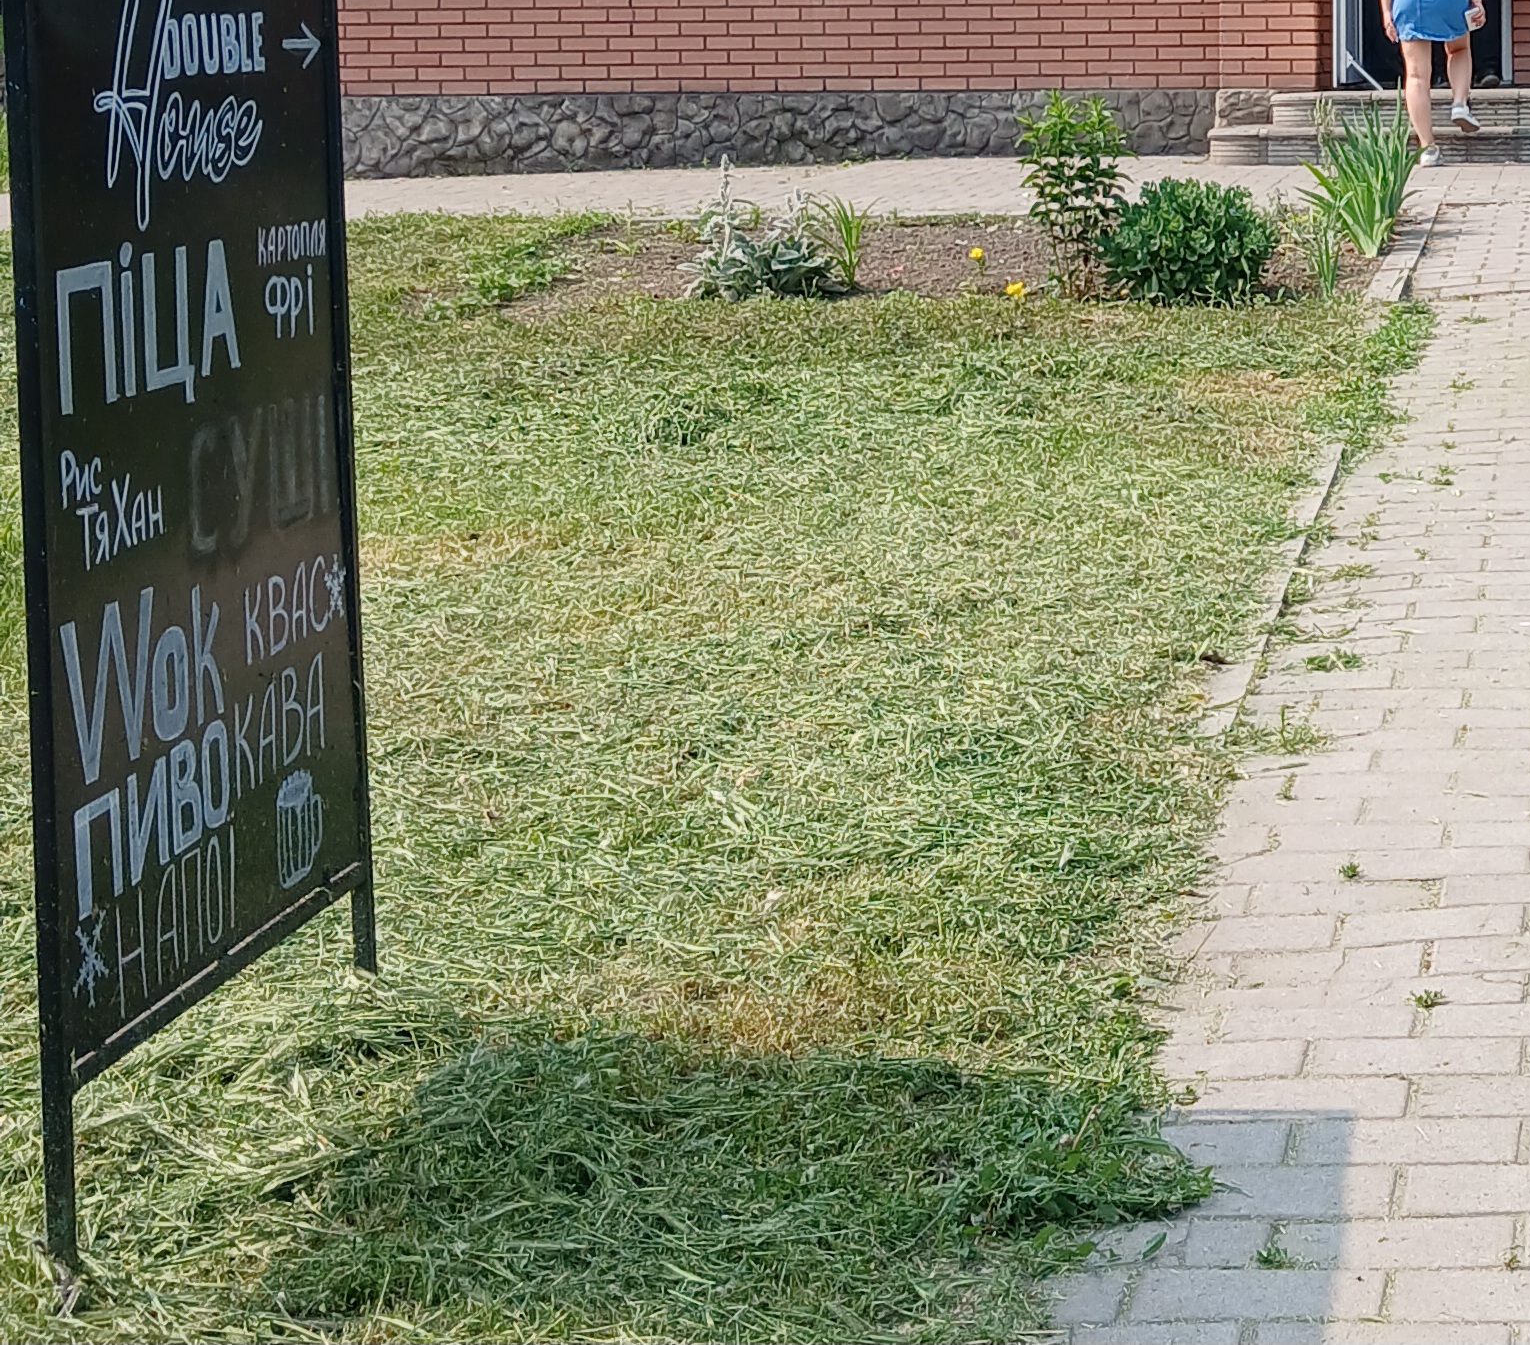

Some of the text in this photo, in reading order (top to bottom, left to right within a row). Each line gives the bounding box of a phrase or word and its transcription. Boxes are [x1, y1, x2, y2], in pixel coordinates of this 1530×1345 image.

[160, 11, 267, 80] DOUBLE
[256, 217, 327, 267] КАРТОПЛЯ
[243, 555, 329, 666] КВАС
[234, 651, 327, 800] КАВА
[73, 719, 232, 922] ПИВО
[115, 811, 237, 1019] НАПОЇ
